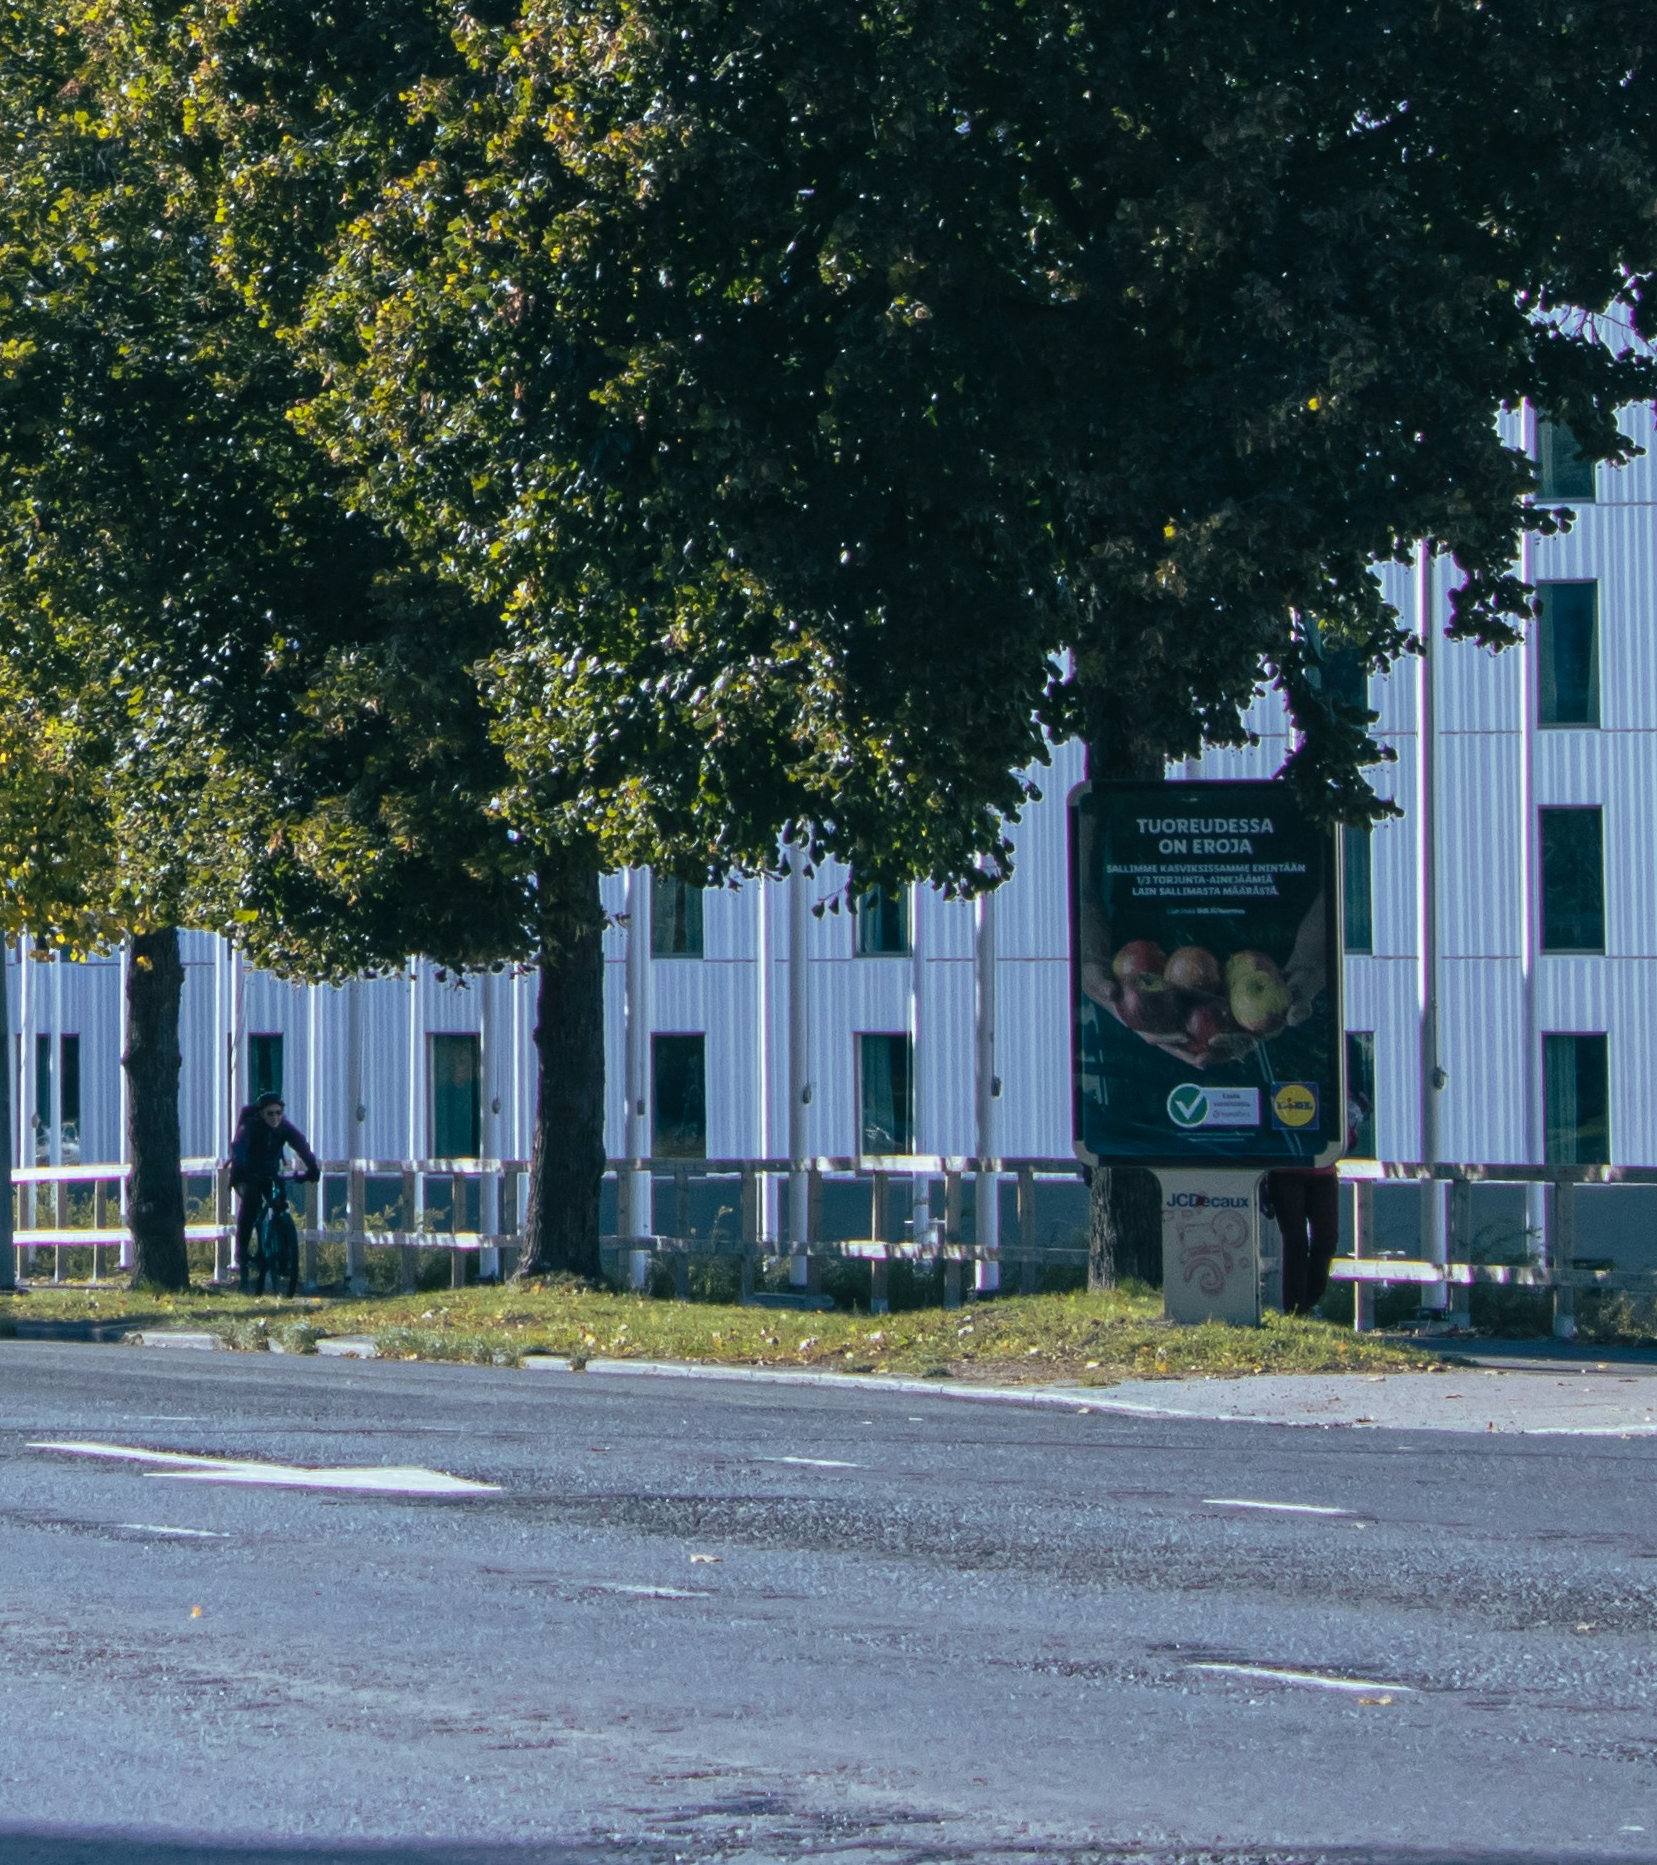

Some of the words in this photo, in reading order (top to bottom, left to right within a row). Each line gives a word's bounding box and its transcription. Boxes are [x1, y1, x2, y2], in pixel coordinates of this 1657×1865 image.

[1136, 818, 1274, 834] TUOREUDESSA
[1158, 839, 1188, 854] ON
[1192, 839, 1253, 854] EROJA
[1106, 864, 1158, 873] SALLIMME
[1132, 887, 1157, 896] LAIN
[1159, 887, 1221, 896] SALLIMASTA
